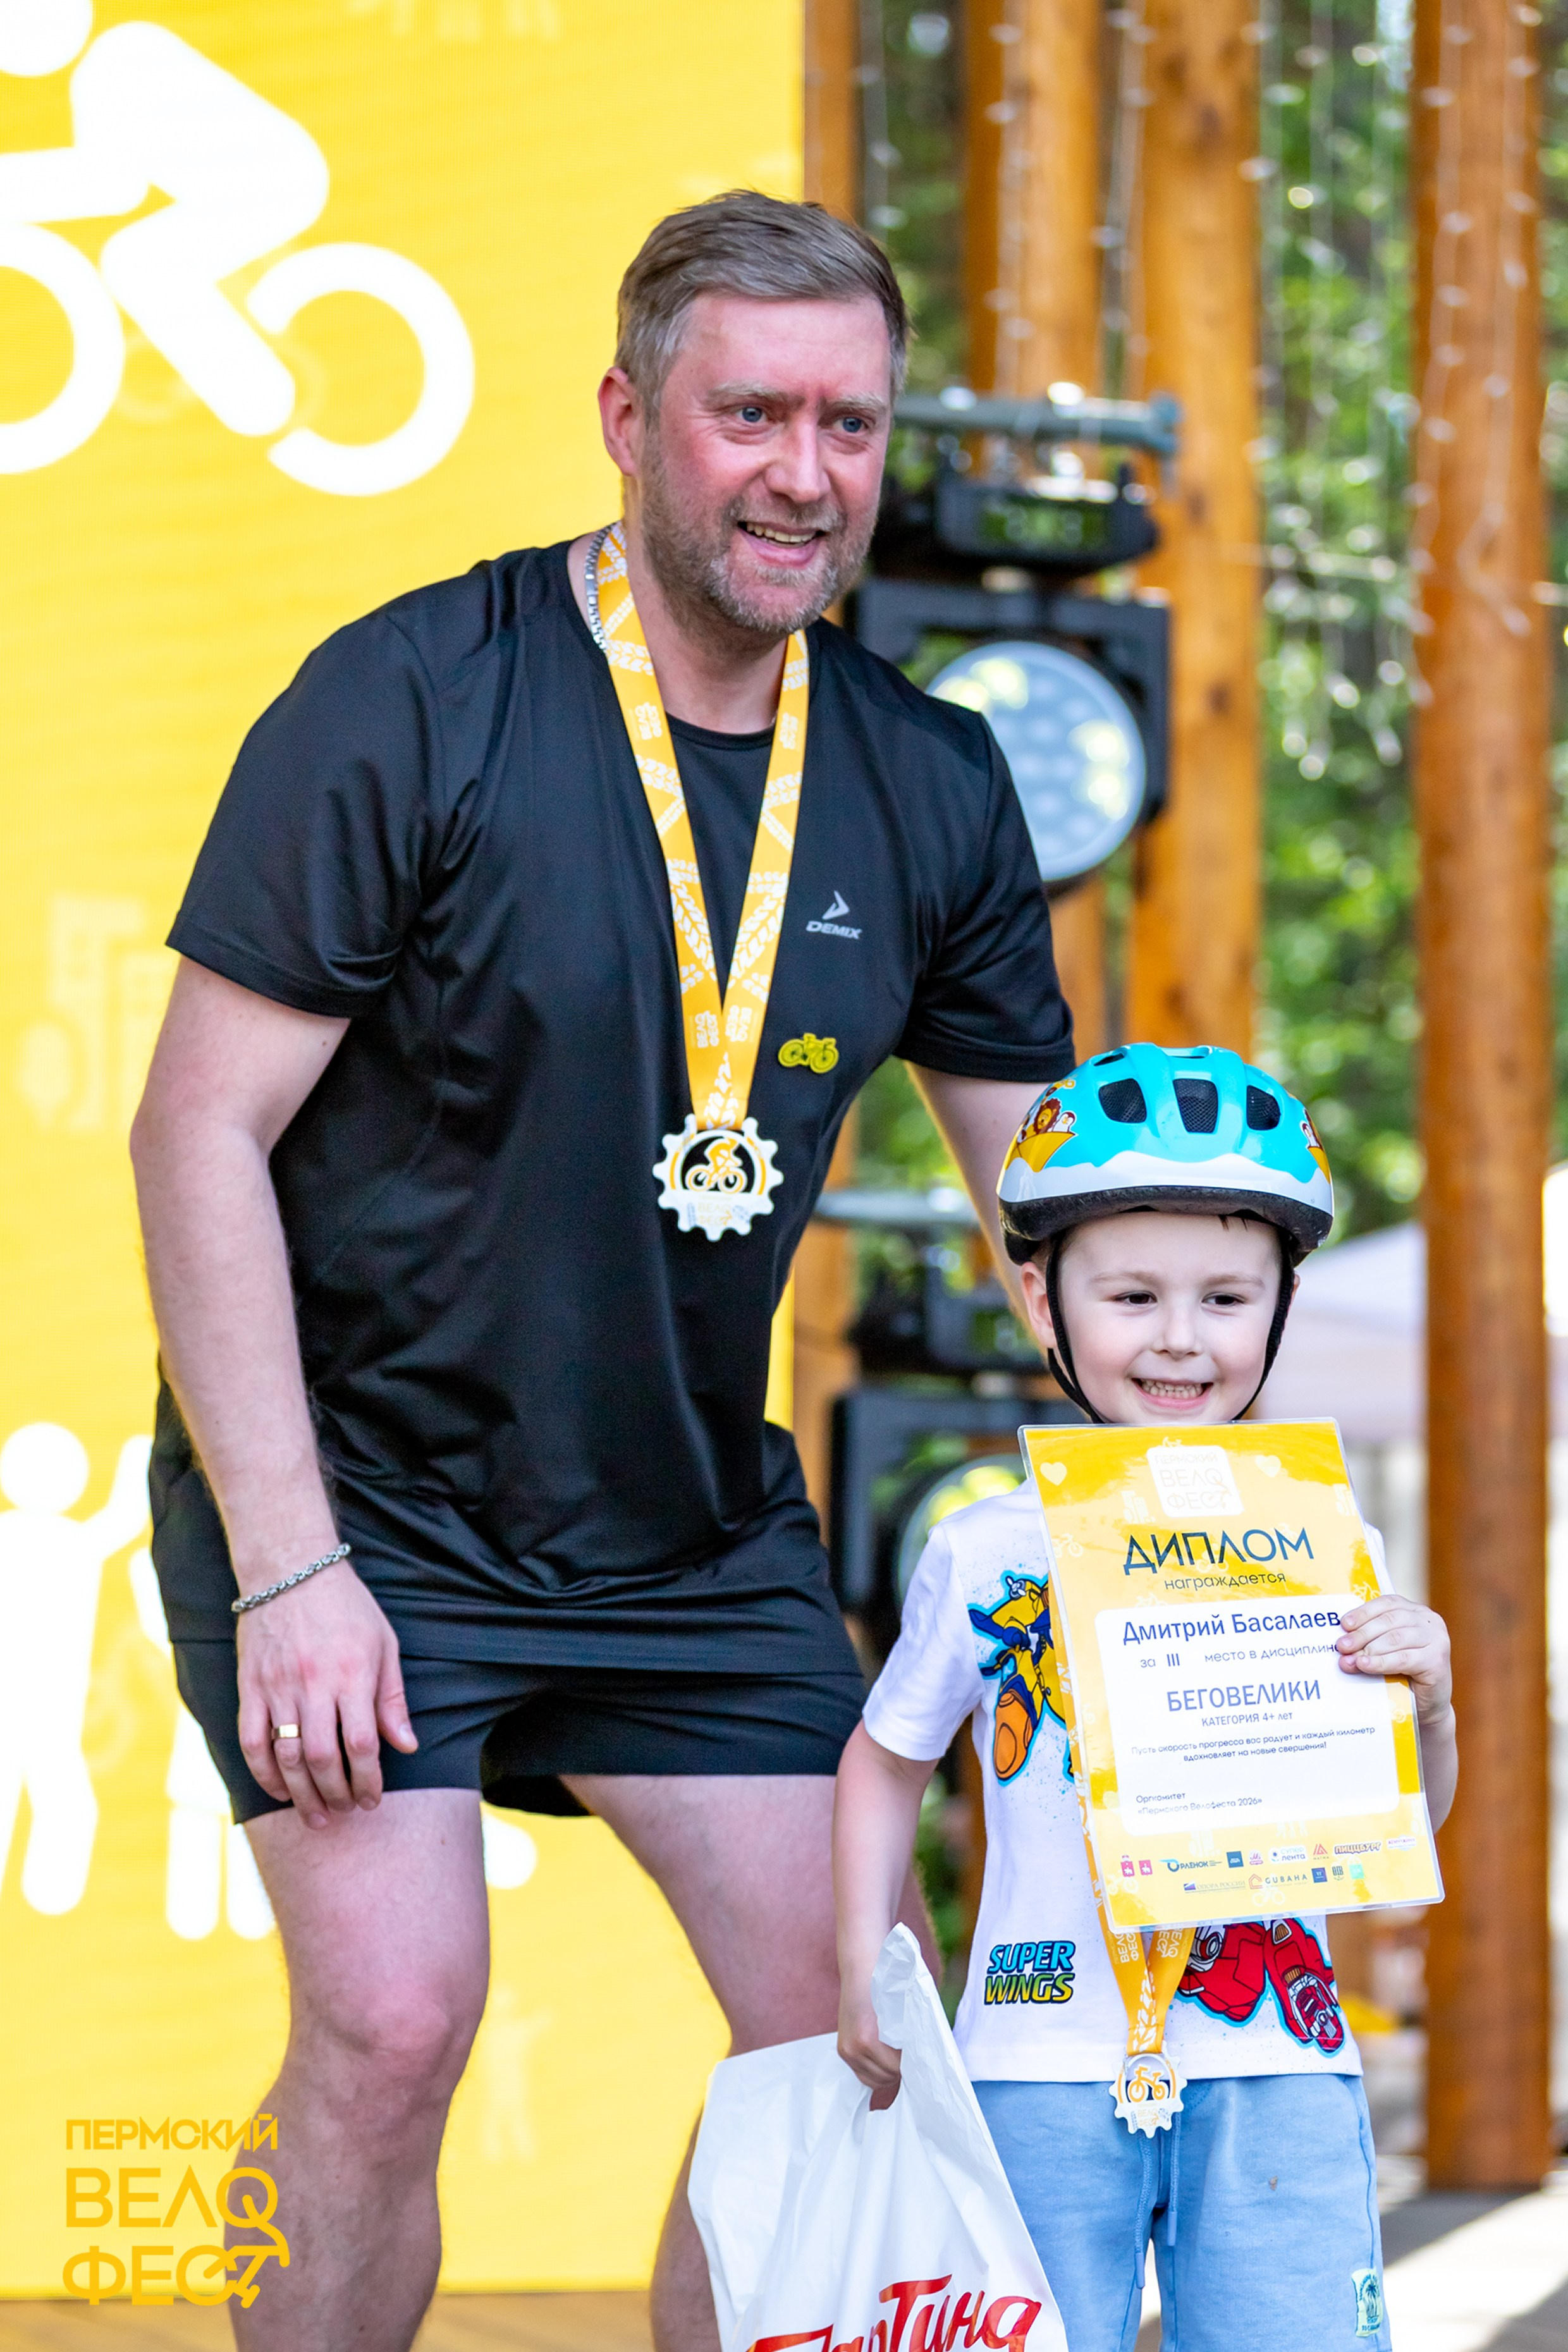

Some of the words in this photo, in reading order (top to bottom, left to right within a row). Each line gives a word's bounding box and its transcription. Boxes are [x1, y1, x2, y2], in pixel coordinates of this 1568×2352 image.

[806, 920, 862, 940] DEMIX
[1124, 1527, 1314, 1576] ДИПЛОМ
[1165, 1572, 1286, 1591] награждается
[1123, 1614, 1225, 1646] Дмитрий
[1232, 1612, 1341, 1633] Басалаев
[1141, 1657, 1156, 1668] за
[1204, 1650, 1246, 1662] место
[1250, 1648, 1256, 1659] в
[1167, 1679, 1321, 1712] БЕГОВЕЛИКИ
[1202, 1713, 1259, 1727] КАТЕГОРИЯ
[1263, 1713, 1275, 1722] 4+
[1278, 1712, 1293, 1720] лет
[1132, 1746, 1156, 1756] Пусть
[1158, 1743, 1197, 1753] скорость
[1199, 1739, 1244, 1749] прогресса
[1263, 1734, 1292, 1744] радует
[1302, 1729, 1335, 1739] каждый
[1336, 1727, 1375, 1736] километр
[1184, 1751, 1235, 1761] вдохновляет
[1251, 1747, 1277, 1756] новые
[1278, 1742, 1327, 1753] свершения!
[1136, 1793, 1186, 1804] Оргкомитет
[1138, 1804, 1189, 1815] «Пермского
[1190, 1800, 1236, 1811] Велофеста
[1237, 1797, 1263, 1806] 2026»
[1334, 1842, 1381, 1854] ПИЦЦБУРГ
[1126, 1933, 1139, 1961] ФЕС
[987, 1940, 1076, 1975] SUPER
[984, 1972, 1075, 2006] WINGS
